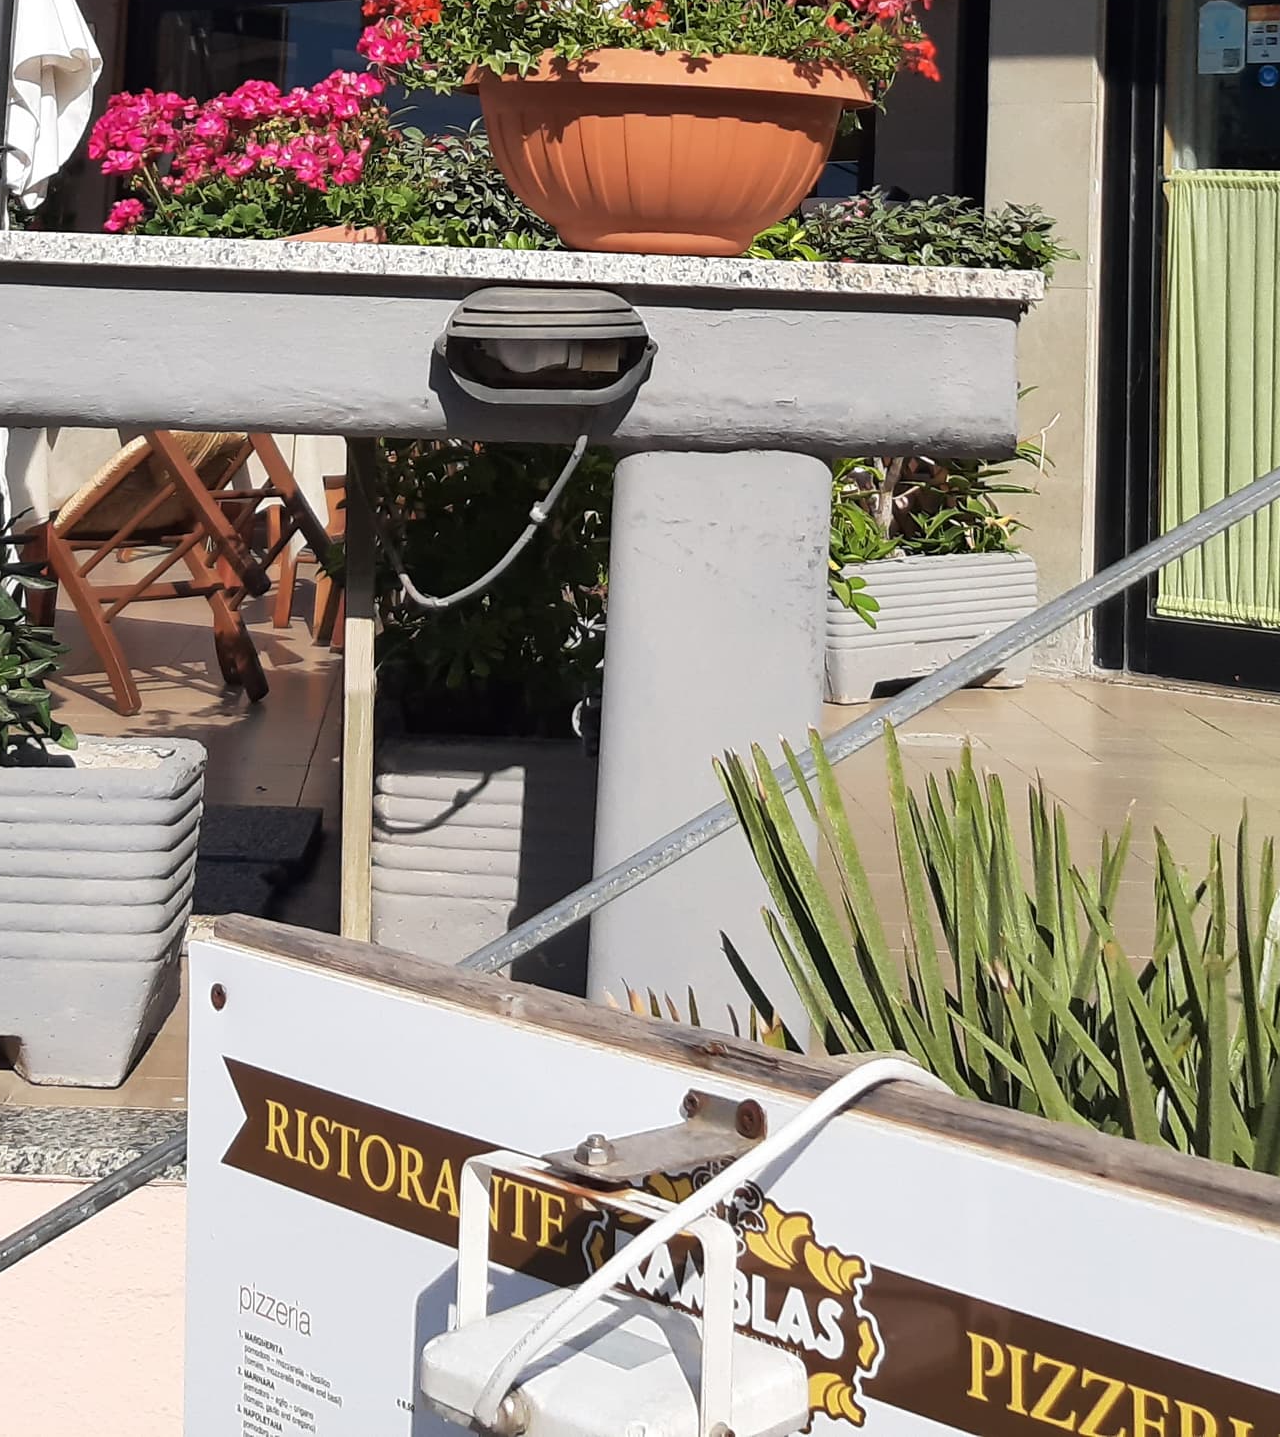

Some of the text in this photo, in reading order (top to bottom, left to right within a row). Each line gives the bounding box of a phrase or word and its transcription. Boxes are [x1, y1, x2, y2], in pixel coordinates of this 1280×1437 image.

[239, 1282, 312, 1336] pizzeria
[244, 1331, 284, 1355] MARGHERITA
[244, 1368, 276, 1390] MARINARA
[243, 1406, 283, 1432] NAPOLETANA
